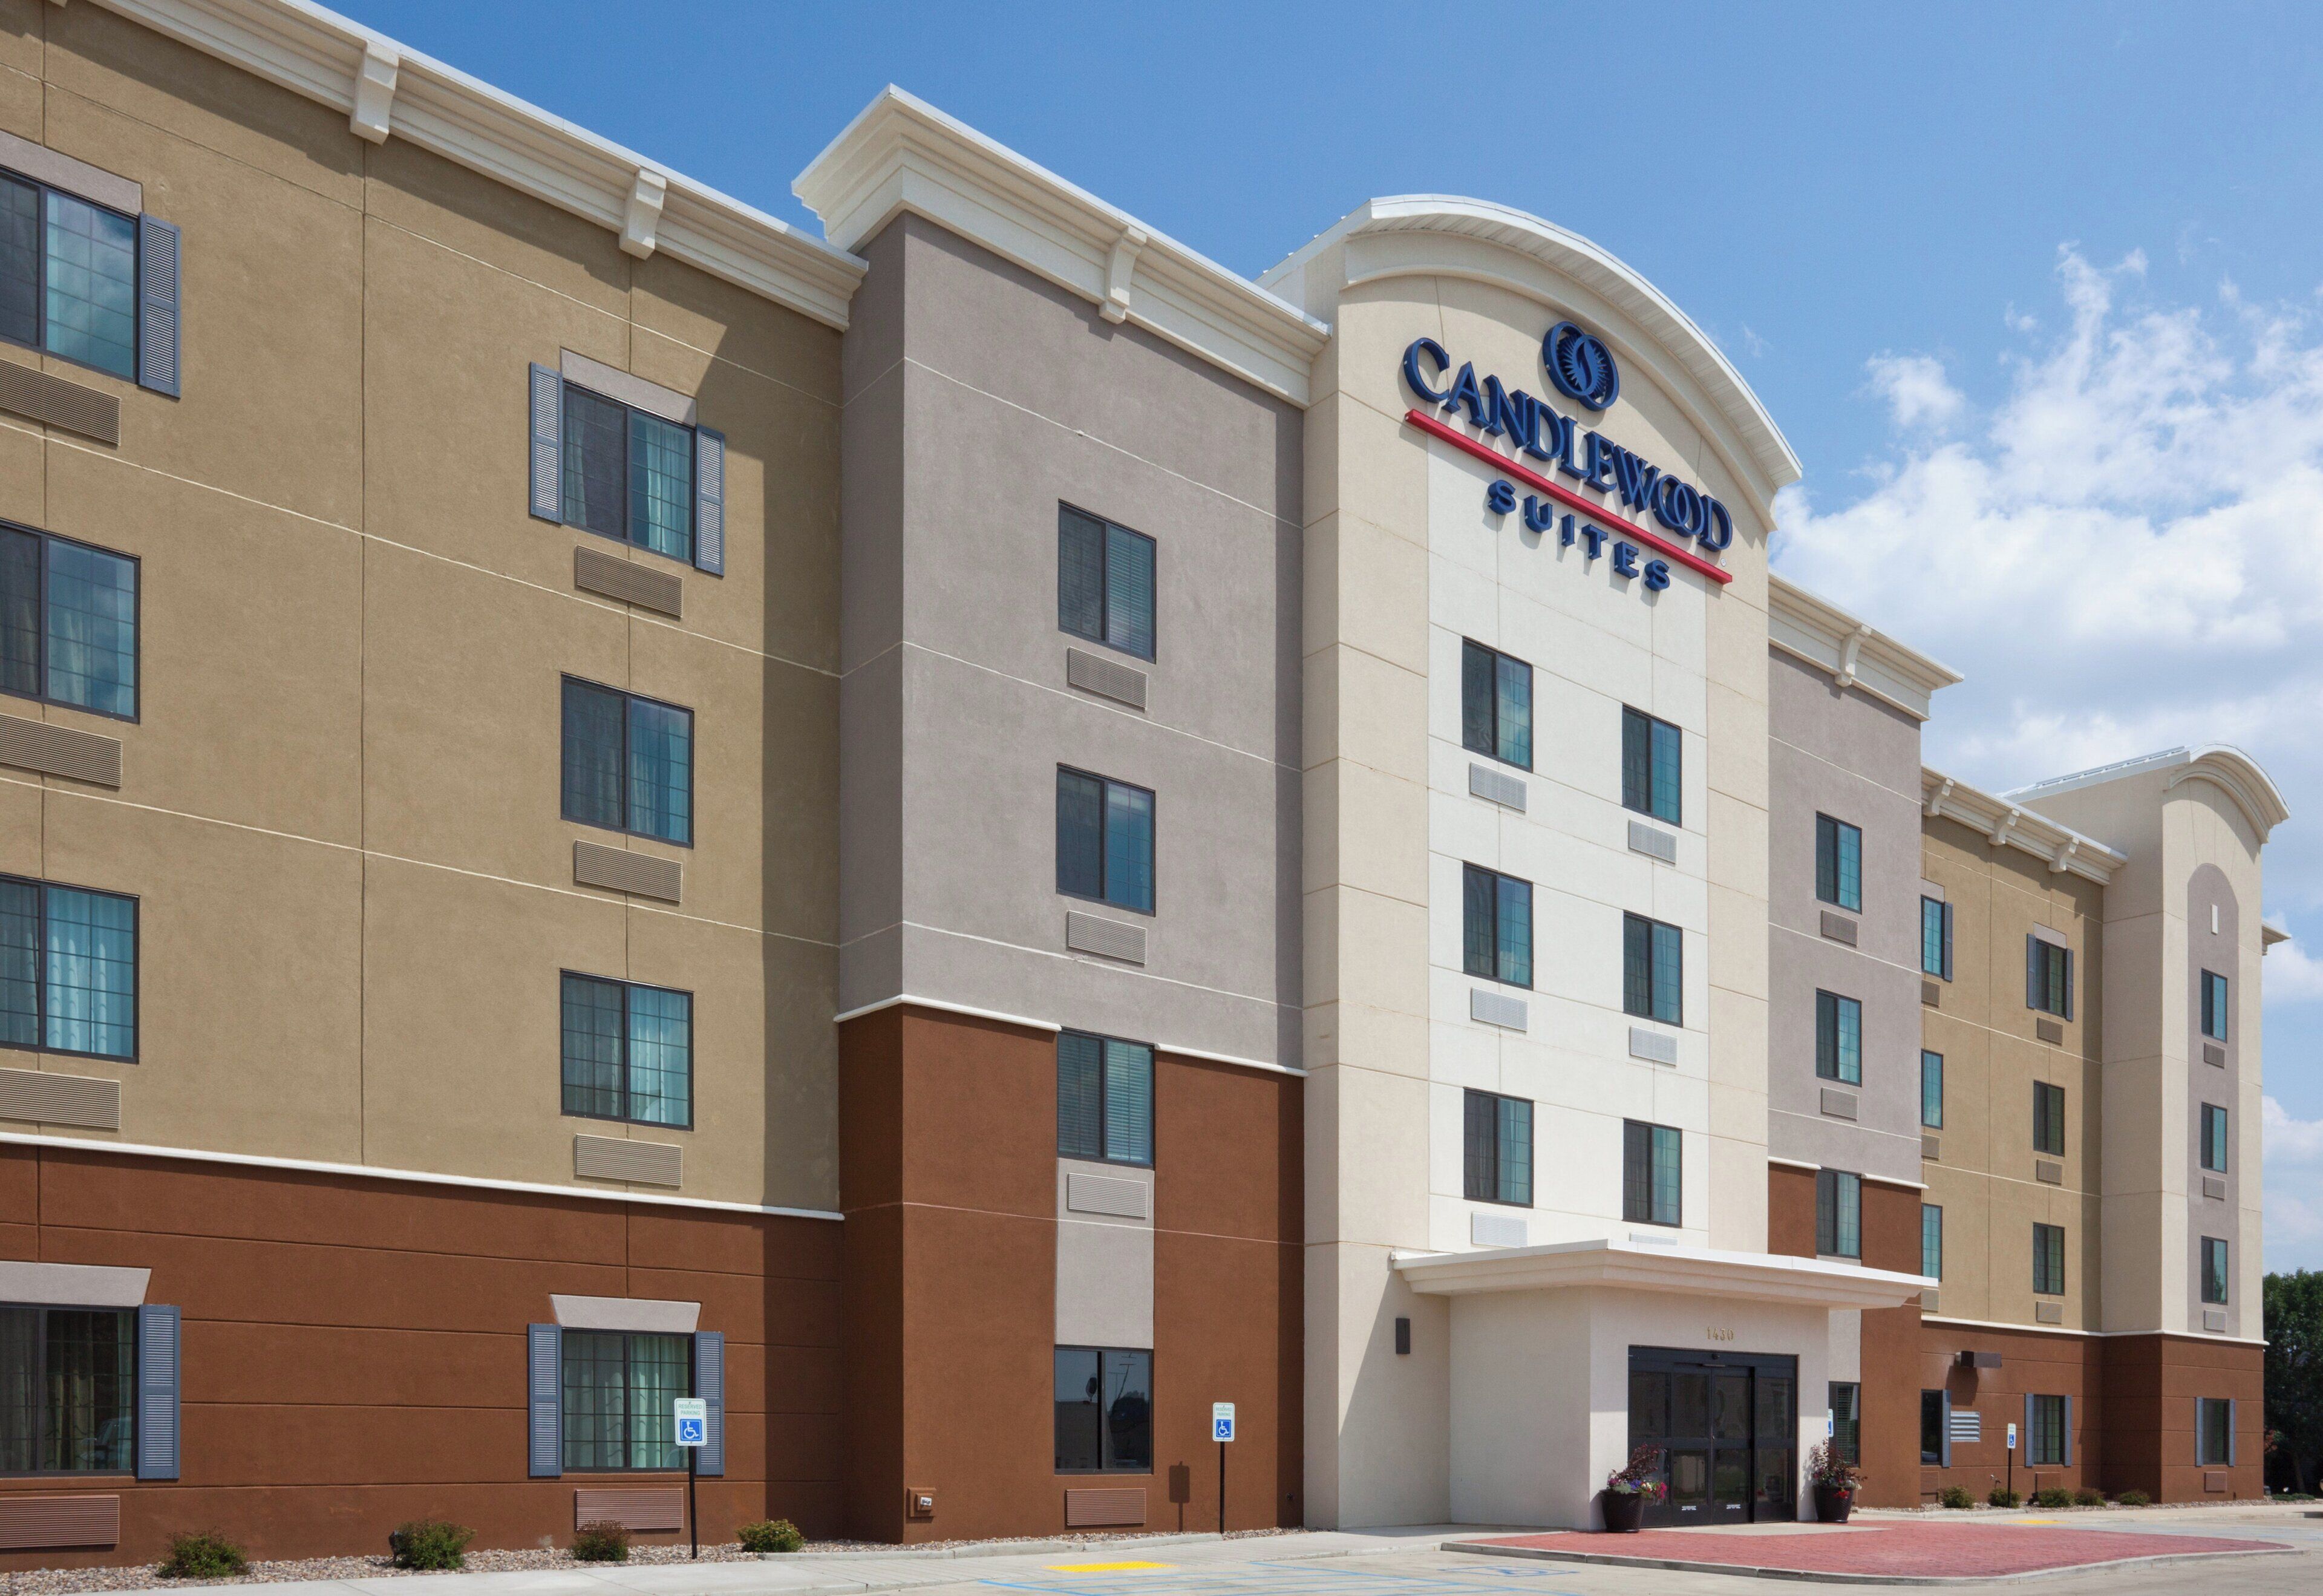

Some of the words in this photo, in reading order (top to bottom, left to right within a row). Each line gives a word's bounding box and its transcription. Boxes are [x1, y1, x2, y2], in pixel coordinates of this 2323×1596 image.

[1403, 337, 1733, 552] CANDLEWOOD
[1488, 479, 1670, 592] SUITES
[1707, 1326, 1734, 1341] 1430
